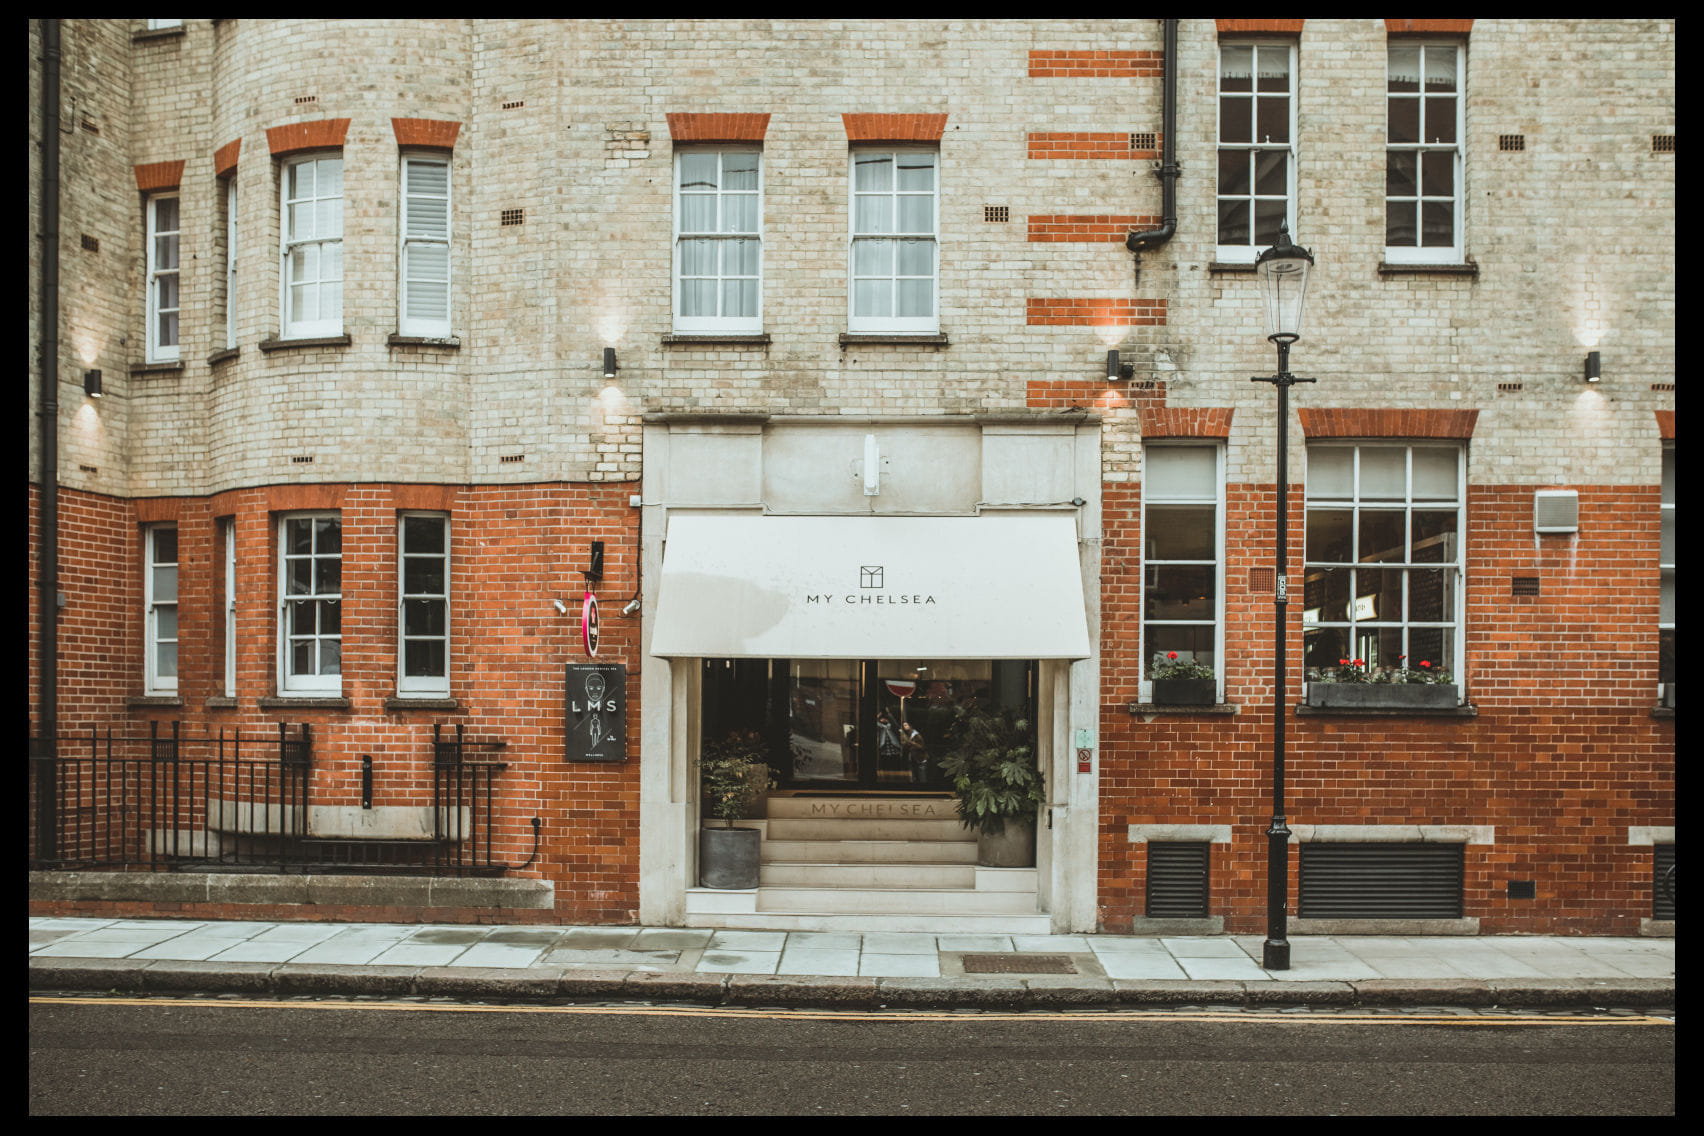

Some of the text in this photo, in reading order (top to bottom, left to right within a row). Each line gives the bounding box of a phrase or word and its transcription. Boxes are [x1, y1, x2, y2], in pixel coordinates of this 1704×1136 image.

[807, 595, 936, 604] MY CHELSEA
[572, 700, 617, 712] LMS
[811, 804, 840, 815] MY
